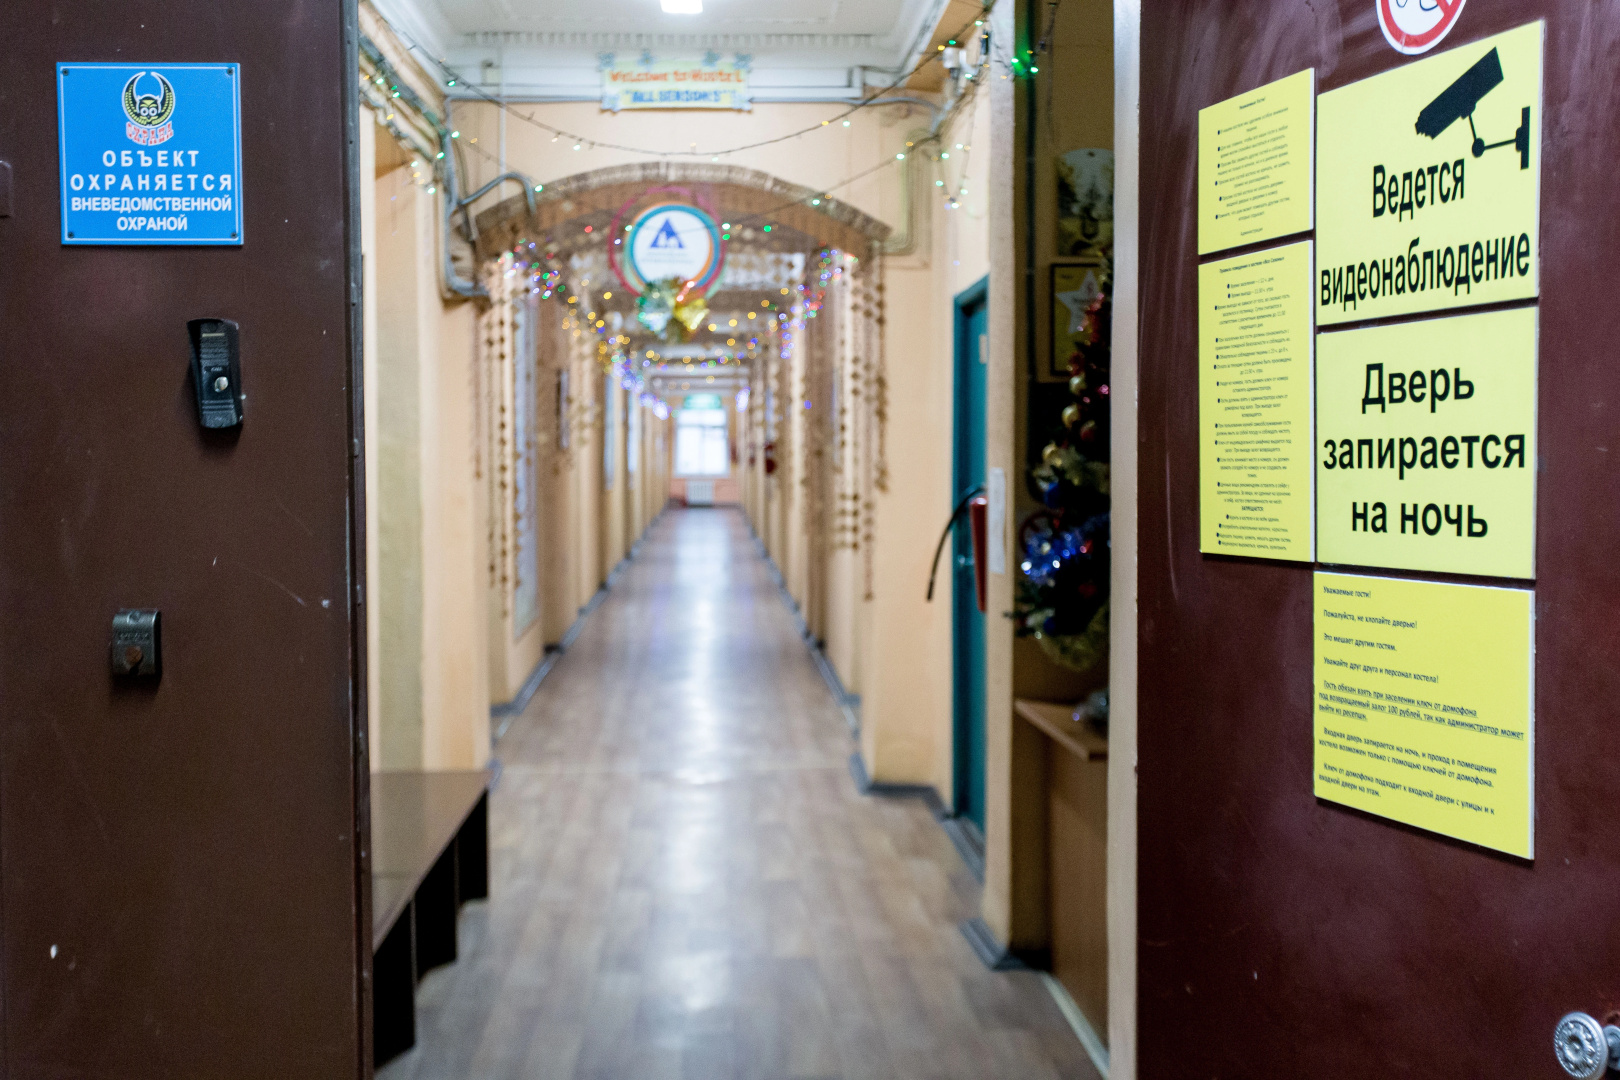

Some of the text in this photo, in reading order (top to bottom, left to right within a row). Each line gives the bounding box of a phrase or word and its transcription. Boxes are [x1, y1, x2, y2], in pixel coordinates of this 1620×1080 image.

[126, 120, 174, 146] ОХРАНА
[102, 150, 199, 167] ОБЪЕКТ
[70, 174, 232, 191] ОХРАНЯЕТСЯ
[1372, 158, 1465, 222] Ведется
[71, 194, 232, 213] ВНЕВЕДОМСТВЕННОЙ
[116, 214, 188, 231] ОХРАНОЙ
[1321, 232, 1531, 312] видеонаблюдение
[1361, 362, 1475, 414] Дверь
[1323, 434, 1526, 480] запирается
[1351, 501, 1488, 538] на ночь
[1323, 586, 1353, 596] Уважаемые
[1364, 616, 1390, 625] хлопайте
[1391, 619, 1417, 628] дверью!
[1323, 632, 1332, 641] Это
[1333, 636, 1353, 644] мешает
[1354, 639, 1375, 647] другим
[1323, 656, 1348, 667] Уважайте
[1349, 662, 1361, 670] друг
[1362, 664, 1378, 673] друга
[1384, 668, 1412, 678] персонал
[1412, 673, 1438, 683] хостела!
[1318, 704, 1334, 712] выйти
[1323, 679, 1336, 690] Гость
[1337, 683, 1356, 693] обязан
[1357, 688, 1372, 696] взять
[1372, 691, 1383, 699] при
[1384, 693, 1415, 704] заселении
[1416, 699, 1432, 708] ключ
[1441, 704, 1476, 716] домофона
[1318, 692, 1328, 700] под
[1329, 694, 1370, 708] возвращаемый
[1371, 703, 1386, 711] залог
[1387, 705, 1398, 714] 100
[1398, 708, 1423, 720] рублей,
[1423, 713, 1433, 721] так
[1446, 718, 1499, 734] администратор
[1500, 728, 1524, 738] может
[1318, 739, 1338, 749] хостела
[1338, 744, 1366, 755] возможен
[1367, 751, 1386, 761] только
[1391, 757, 1421, 770] помощью
[1422, 764, 1446, 775] ключей
[1447, 770, 1454, 778] от
[1456, 772, 1494, 787] домофона.
[1323, 726, 1345, 738] Входная
[1346, 734, 1362, 743] дверь
[1363, 738, 1394, 750] запирается
[1404, 748, 1421, 757] ночь,
[1427, 752, 1450, 764] проход
[1456, 759, 1496, 774] помещения
[1318, 774, 1340, 785] входной
[1340, 780, 1357, 790] двери
[1323, 762, 1337, 772] Ключ
[1345, 769, 1373, 782] домофона
[1374, 777, 1402, 790] подходит
[1407, 786, 1433, 798] входной
[1434, 793, 1454, 804] двери
[1460, 800, 1482, 811] улицы
